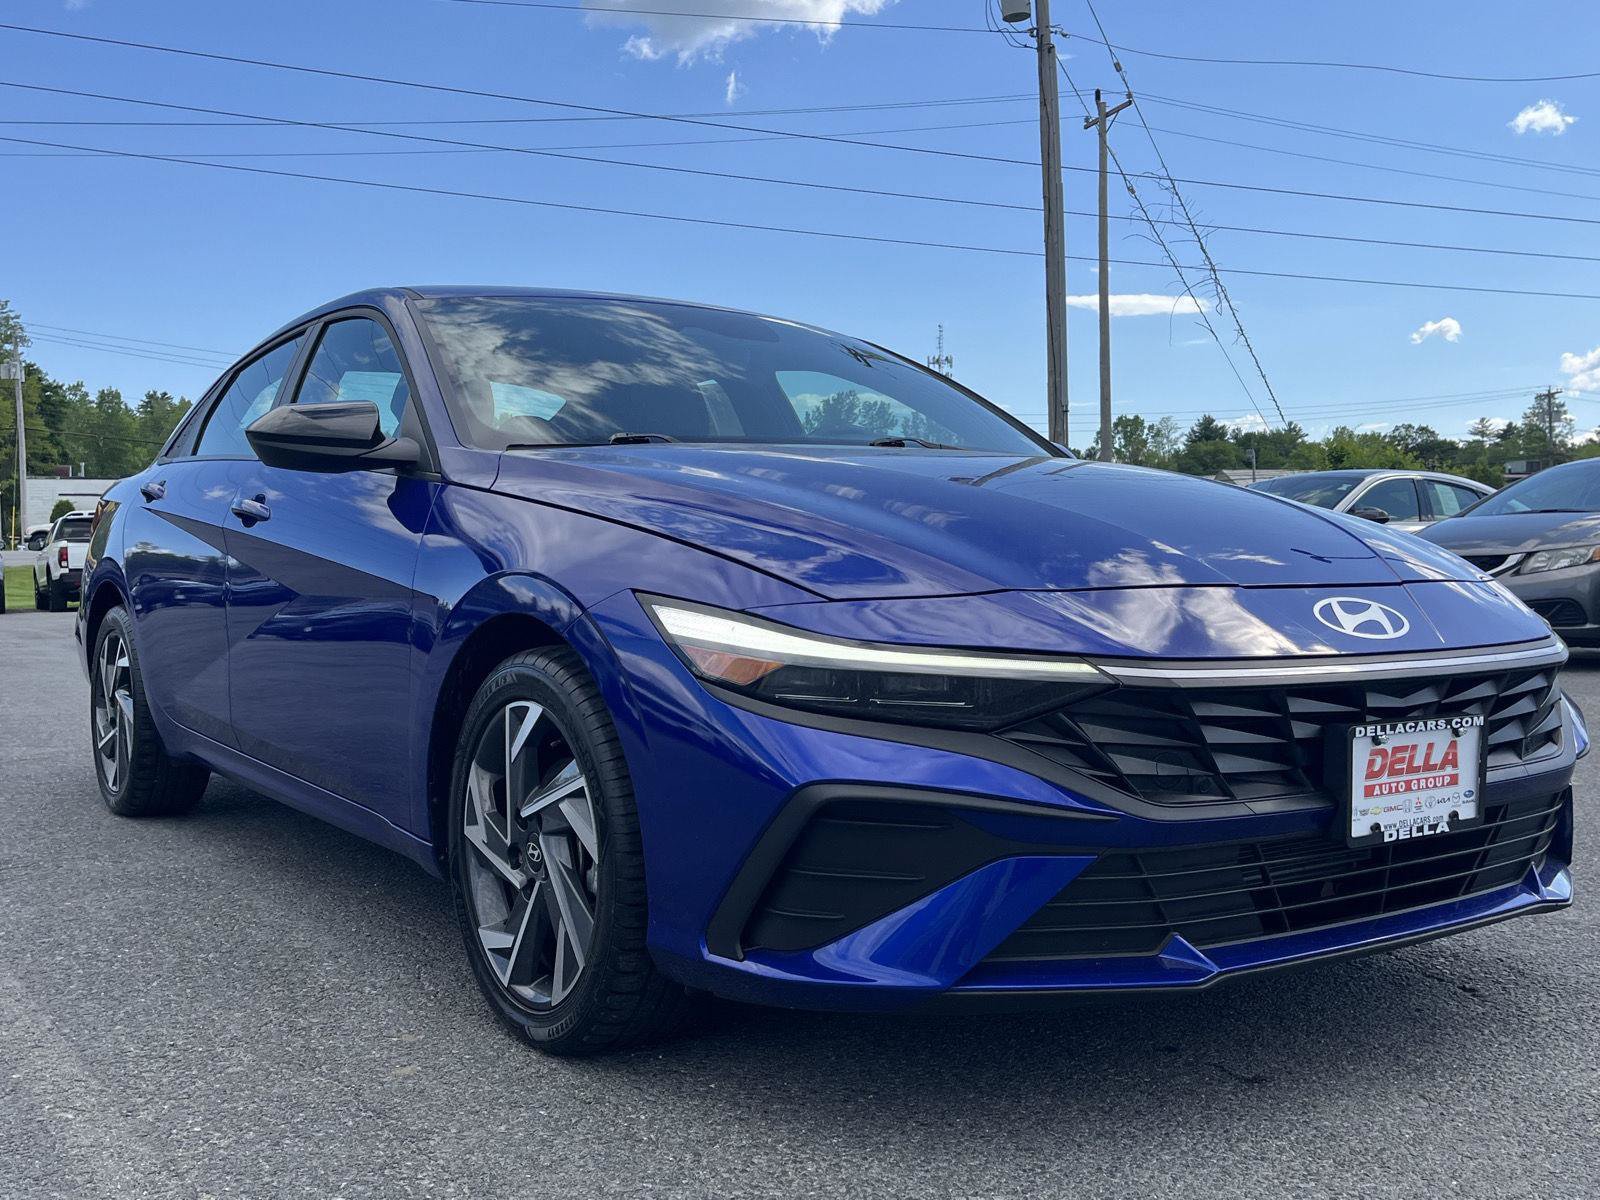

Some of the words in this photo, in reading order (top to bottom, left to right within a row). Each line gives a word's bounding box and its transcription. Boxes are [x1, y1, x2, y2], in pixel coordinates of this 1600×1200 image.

[1355, 715, 1484, 738] DELLACARS.COM
[1364, 740, 1459, 782] DELLA
[1373, 782, 1405, 796] AUTO
[1411, 775, 1451, 791] GROUP
[1383, 805, 1403, 813] GMC
[1384, 821, 1450, 842] DELLA
